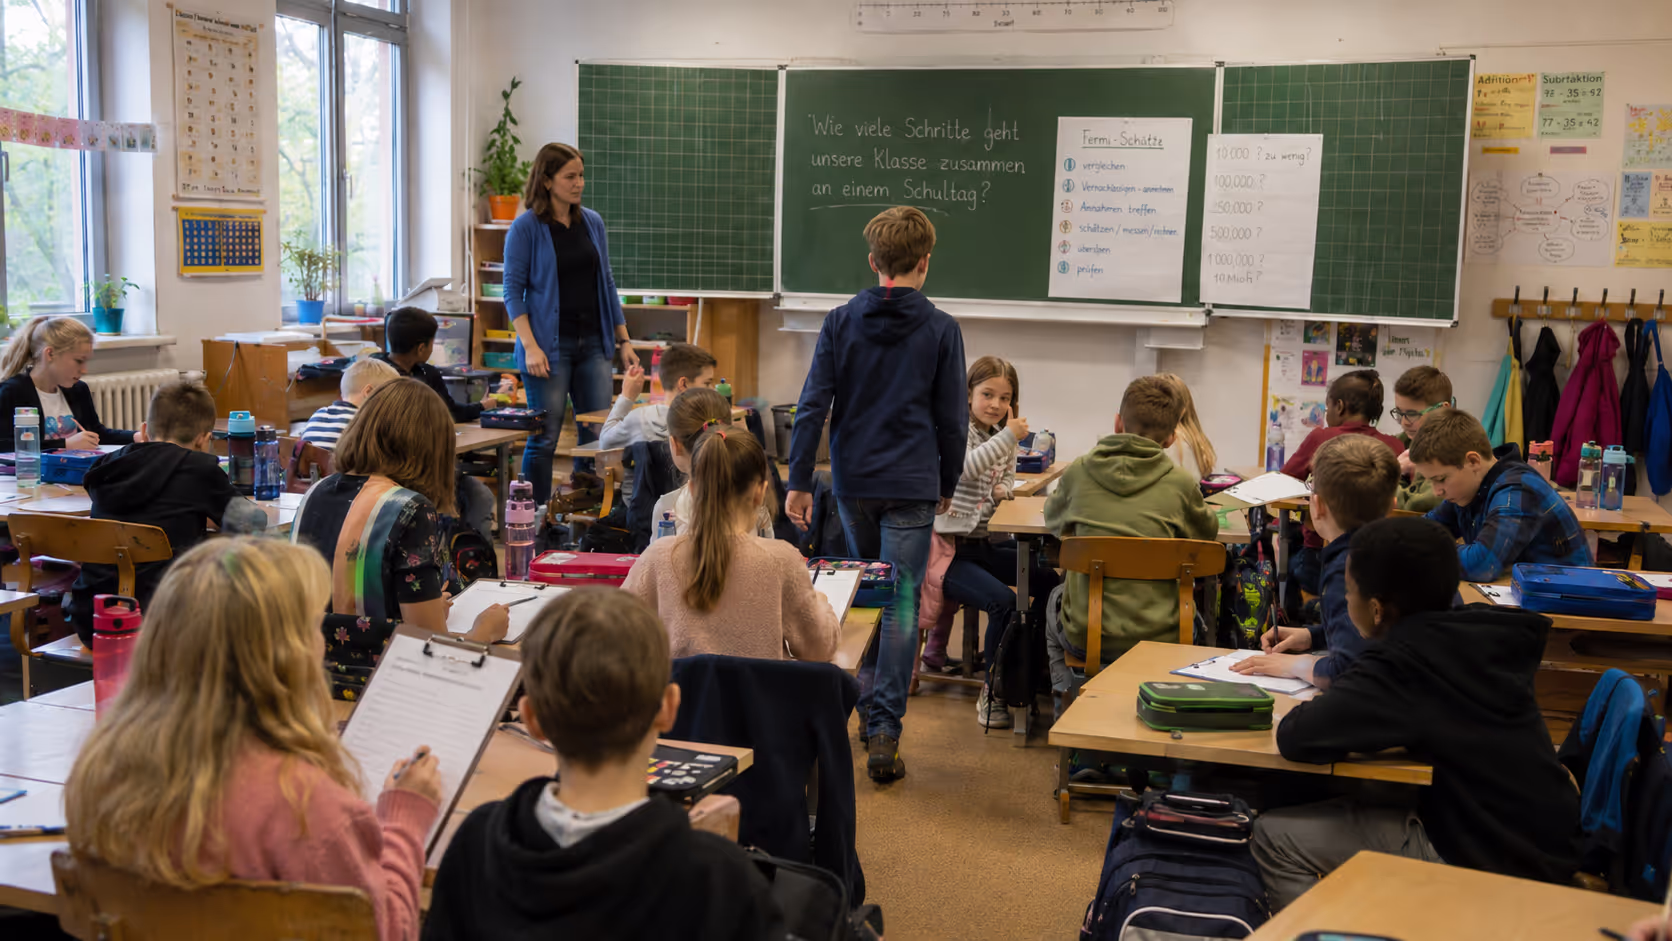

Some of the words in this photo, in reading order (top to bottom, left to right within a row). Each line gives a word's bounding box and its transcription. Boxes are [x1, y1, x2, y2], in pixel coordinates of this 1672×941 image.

[811, 114, 843, 136] Wie
[855, 116, 892, 137] viele
[905, 117, 971, 140] Schritte
[984, 114, 1019, 151] geht
[811, 153, 863, 168] unsere
[874, 147, 927, 170] Klasse
[940, 157, 1025, 174] zusammen
[1265, 152, 1276, 161] zu
[812, 181, 832, 196] an
[842, 180, 889, 197] einem
[904, 178, 991, 211] Schultag?
[1128, 203, 1157, 217] treffen
